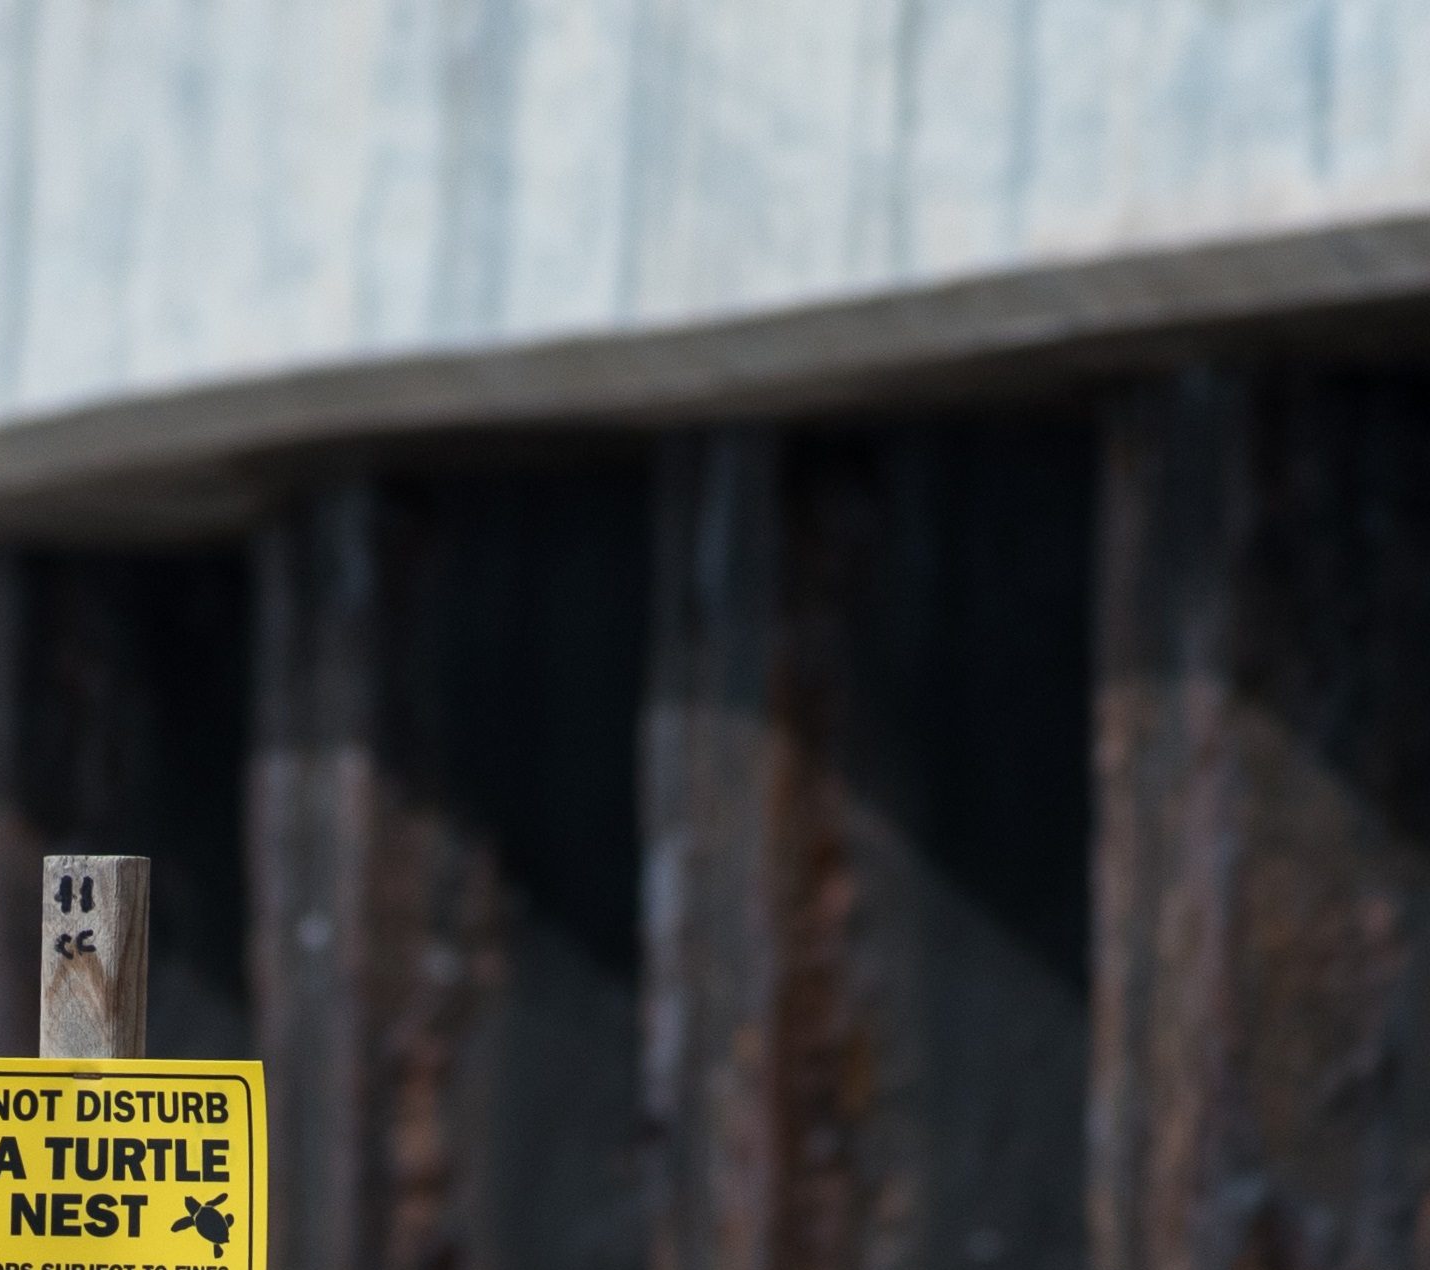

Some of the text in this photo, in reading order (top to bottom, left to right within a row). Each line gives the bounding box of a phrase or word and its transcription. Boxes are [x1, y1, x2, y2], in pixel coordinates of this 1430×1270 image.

[76, 1090, 229, 1124] DISTURB
[44, 1136, 230, 1182] TURTLE
[10, 1192, 148, 1238] NEST
